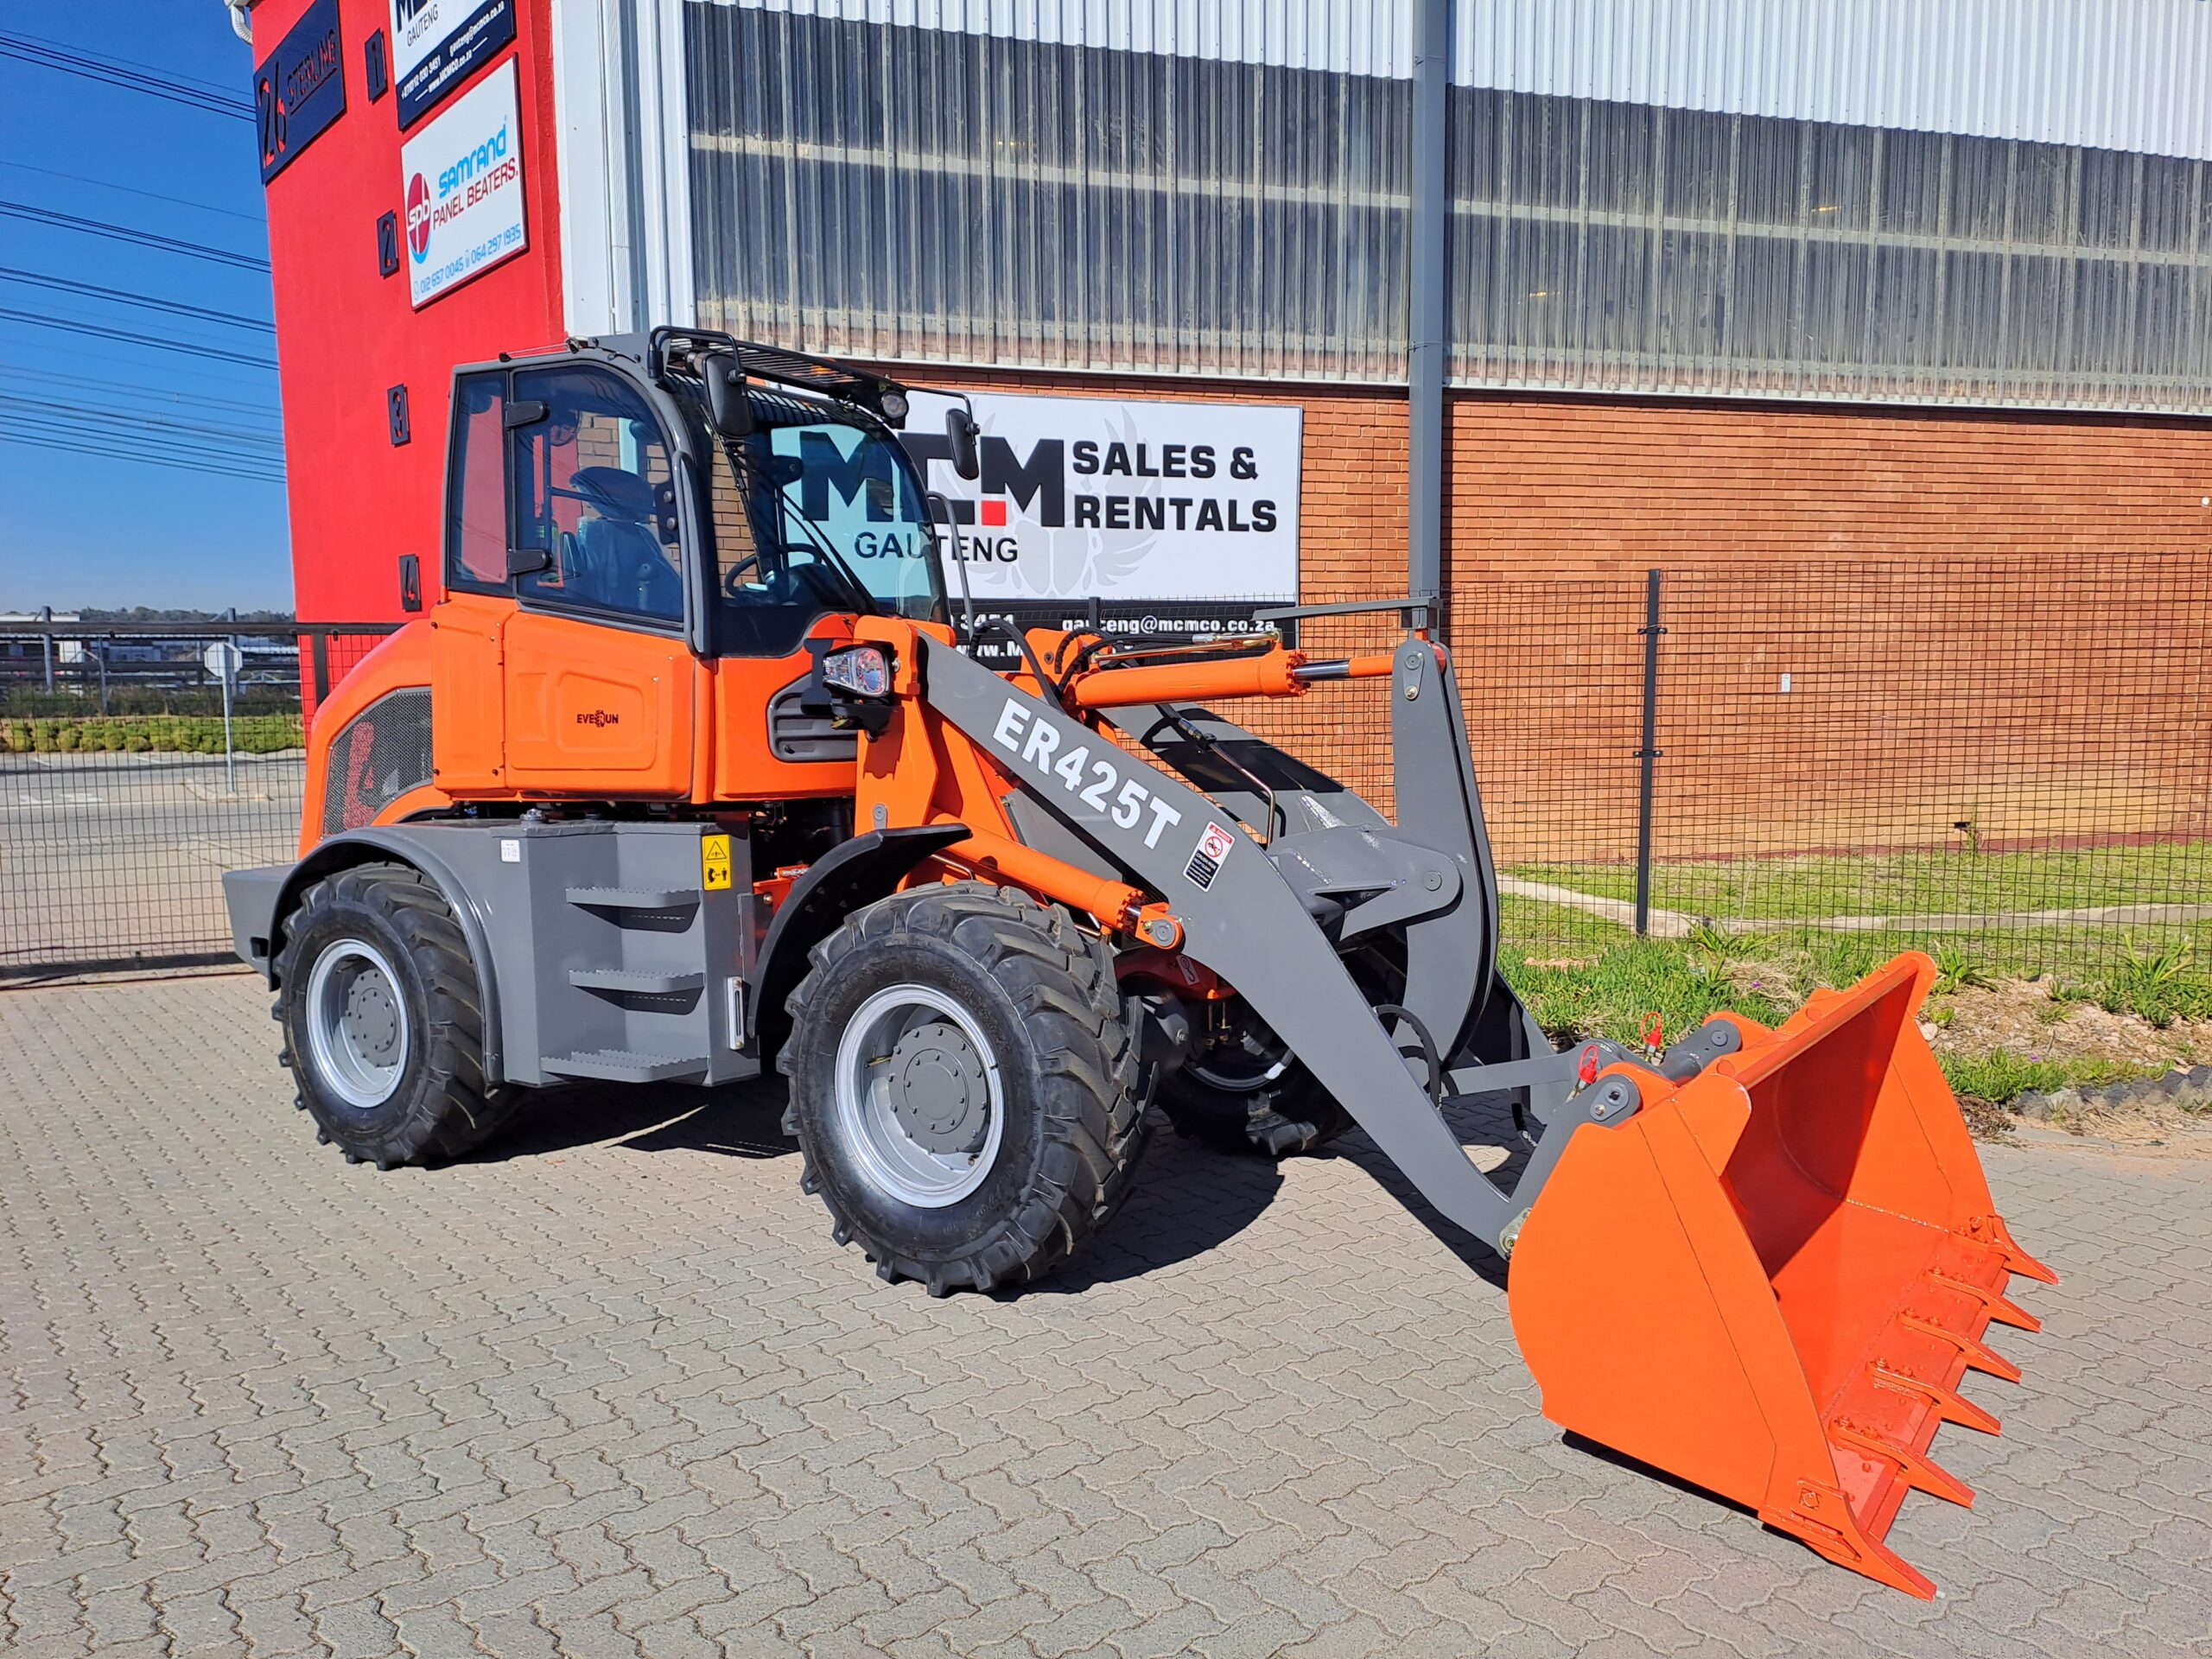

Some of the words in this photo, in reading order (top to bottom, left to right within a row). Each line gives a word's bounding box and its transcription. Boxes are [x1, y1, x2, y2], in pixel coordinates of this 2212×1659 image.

[407, 3, 439, 48] GAUTENG
[287, 29, 336, 107] STERLING
[259, 60, 287, 169] 26
[433, 194, 464, 231] PANEL
[467, 156, 519, 208] BEATERS.
[383, 219, 392, 269] 2
[420, 276, 431, 294] 012
[432, 269, 445, 289] 657
[445, 257, 465, 281] 0045
[471, 245, 486, 265] 064
[487, 234, 503, 257] 297
[503, 223, 521, 246] 1935
[393, 391, 403, 438] 3
[1072, 440, 1217, 479] SALES
[1230, 446, 1259, 480] &
[1074, 494, 1277, 532] RENTALS
[1062, 614, 1275, 635] gaeng@mcmco.co.za
[992, 696, 1183, 850] ER425T
